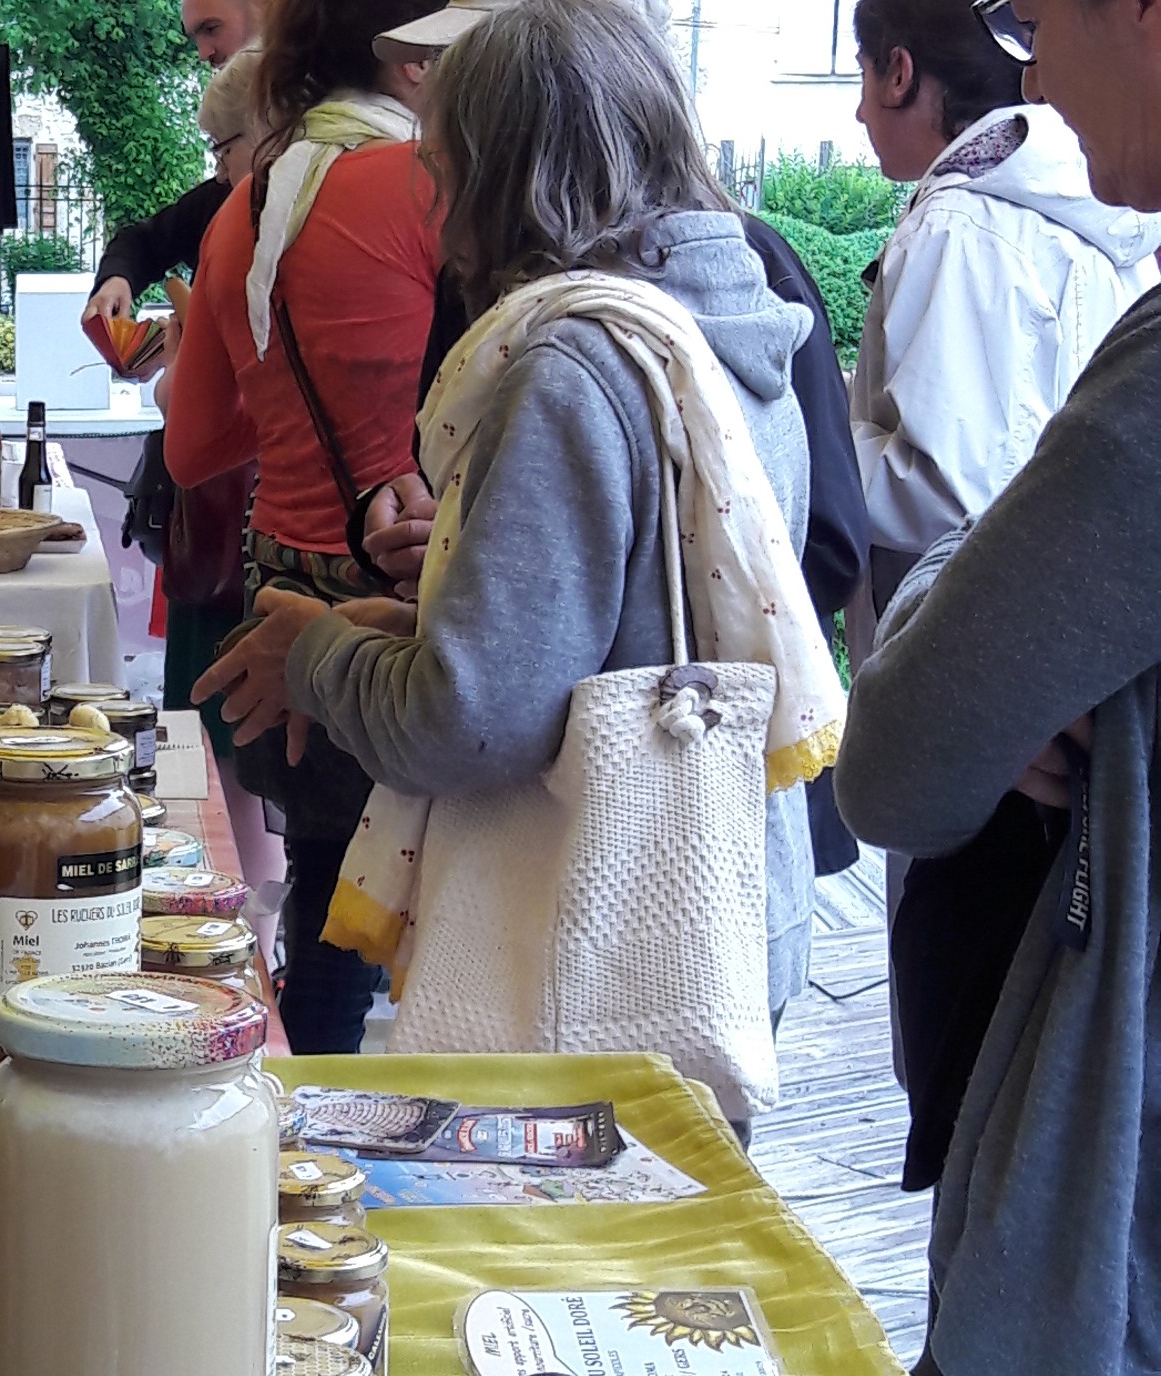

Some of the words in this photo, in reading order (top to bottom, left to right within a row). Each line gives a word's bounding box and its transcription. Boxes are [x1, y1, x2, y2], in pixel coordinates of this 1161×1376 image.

[61, 864, 95, 878] MIEL
[98, 862, 113, 874] DE
[115, 856, 137, 872] SARR
[51, 908, 69, 923] LES
[13, 935, 40, 947] Miel
[560, 1296, 591, 1327] DORÉ
[575, 1328, 603, 1368] SOLEIL
